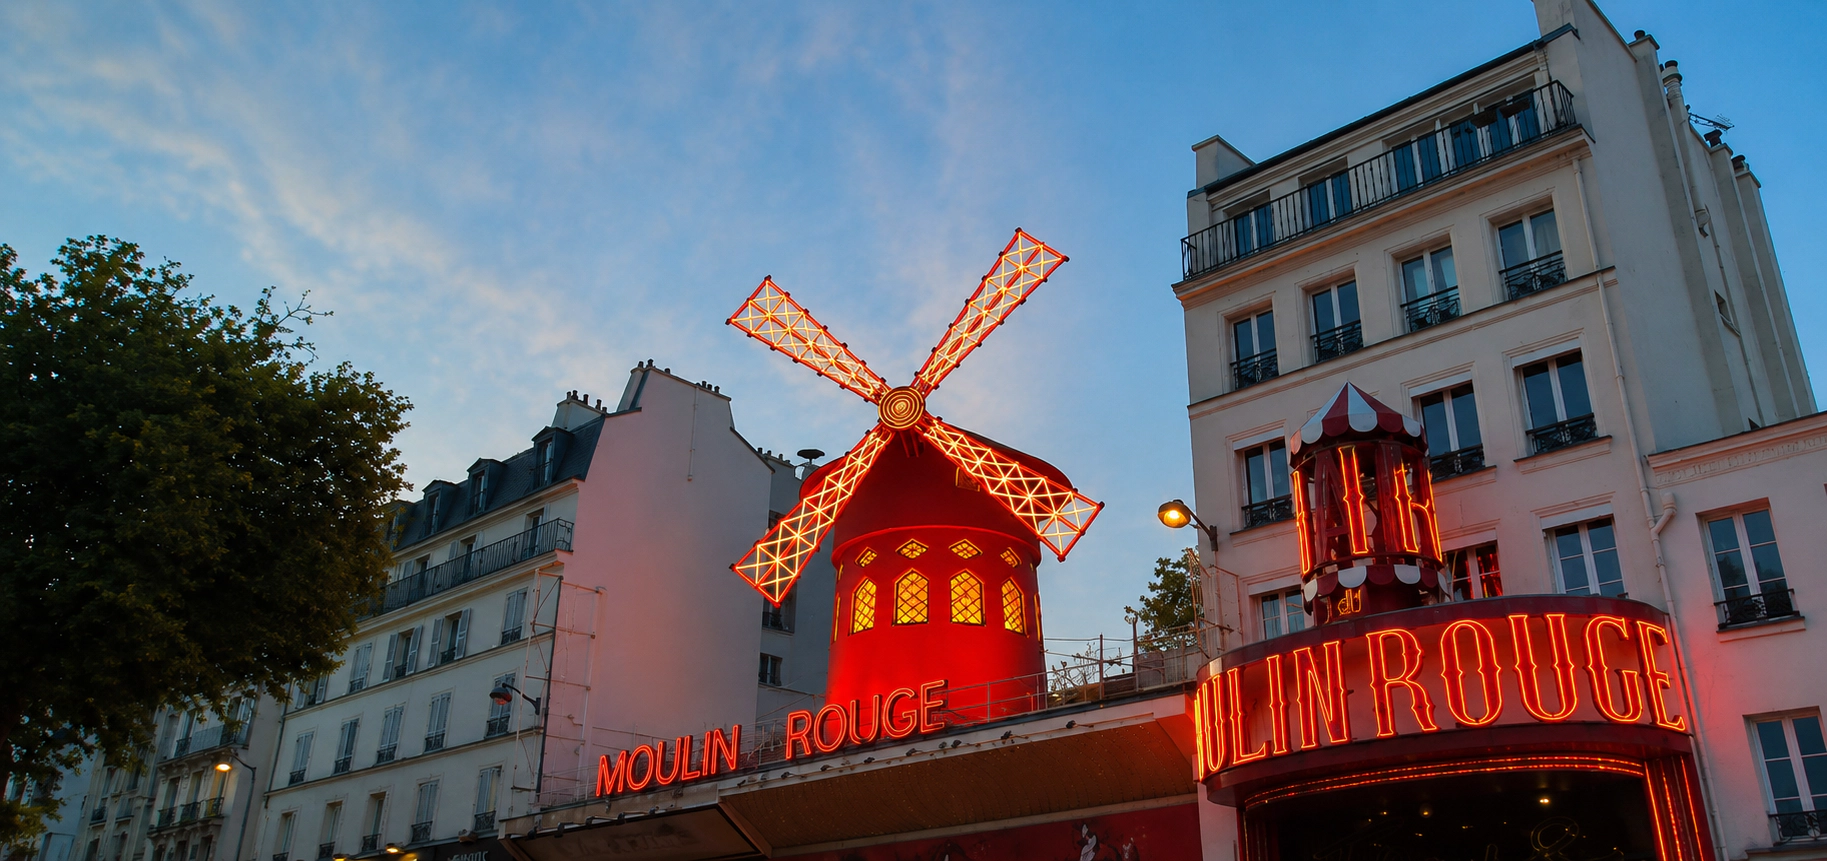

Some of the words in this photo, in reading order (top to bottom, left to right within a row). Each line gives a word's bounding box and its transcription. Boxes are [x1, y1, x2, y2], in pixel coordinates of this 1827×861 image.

[595, 724, 743, 798] MOULIN
[784, 678, 948, 761] ROUGE
[1194, 639, 1350, 782] ULIN
[1365, 613, 1686, 736] ROUGE
